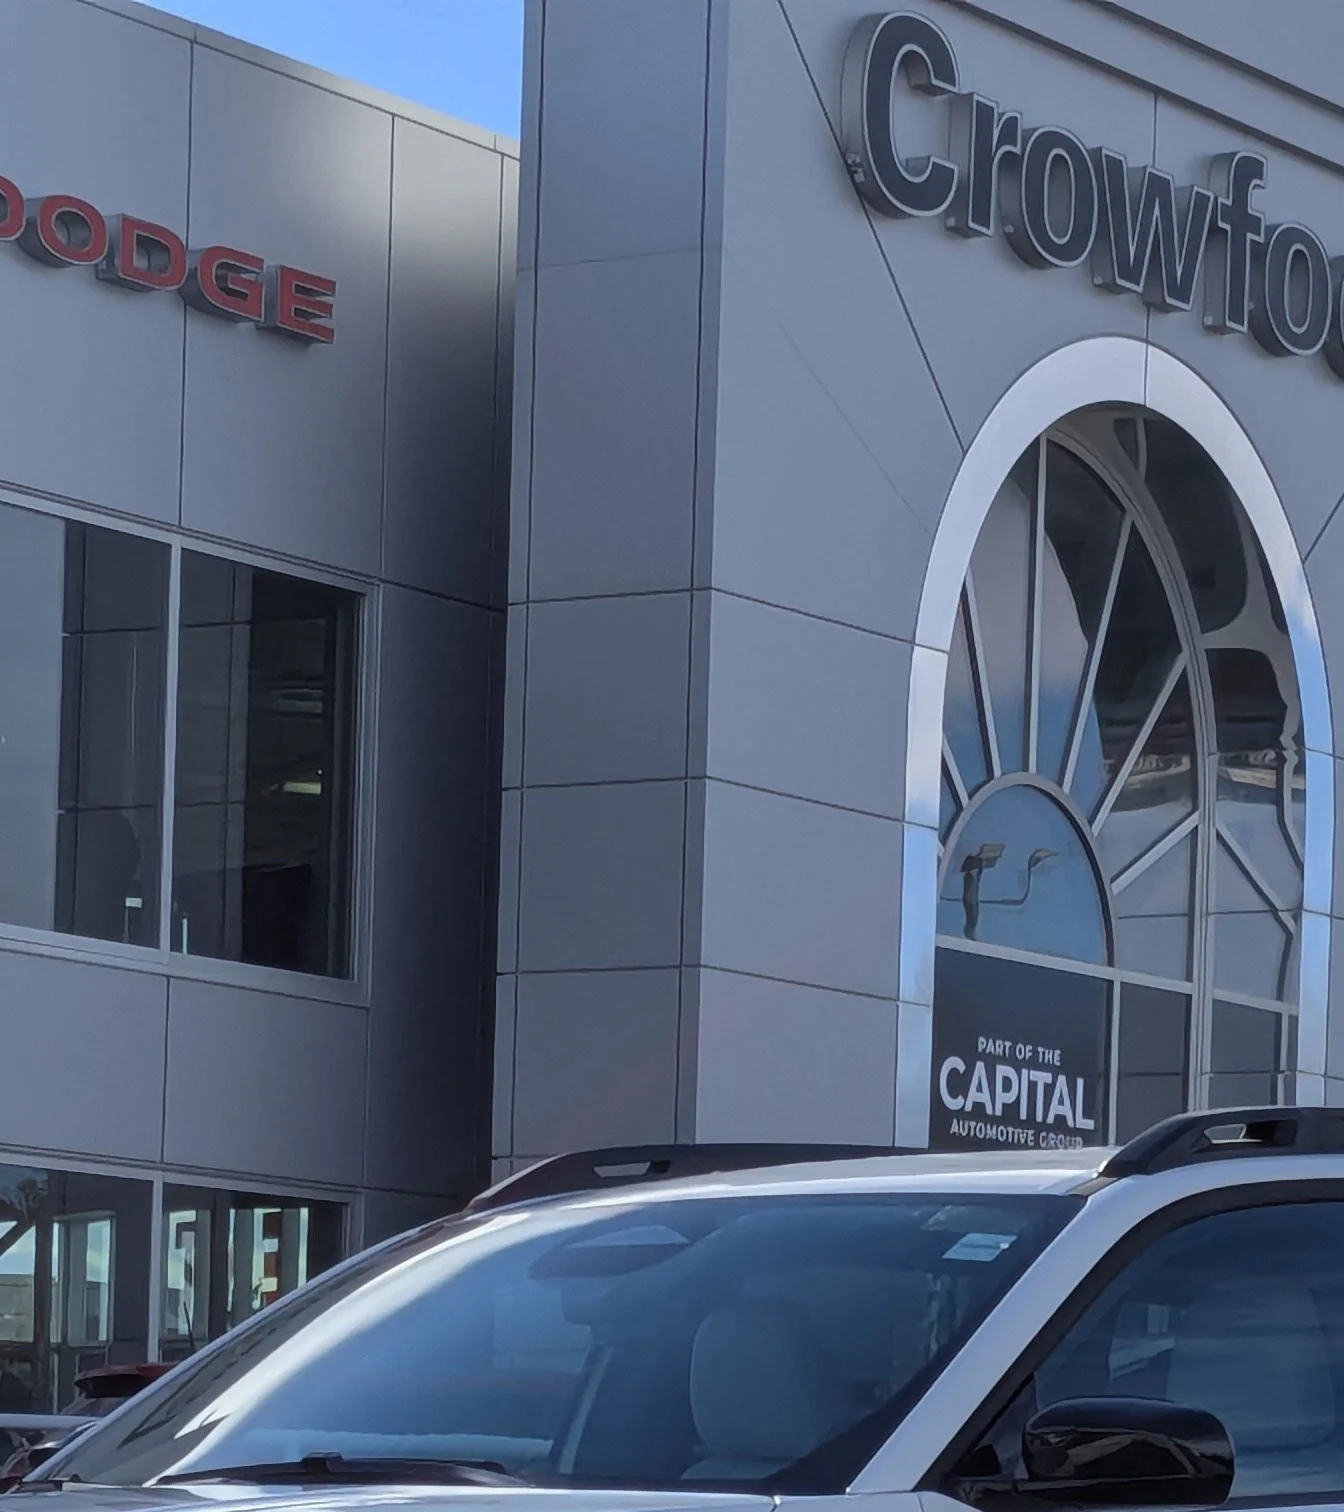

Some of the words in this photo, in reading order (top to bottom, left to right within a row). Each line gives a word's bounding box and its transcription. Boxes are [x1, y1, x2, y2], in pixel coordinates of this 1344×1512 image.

[977, 1036, 1012, 1057] PART
[1015, 1042, 1033, 1061] OF
[1037, 1046, 1061, 1066] THE
[939, 1055, 1095, 1131] CAPITAL
[949, 1118, 1036, 1146] AUTOMOTIVE
[1039, 1131, 1084, 1152] GROUP
